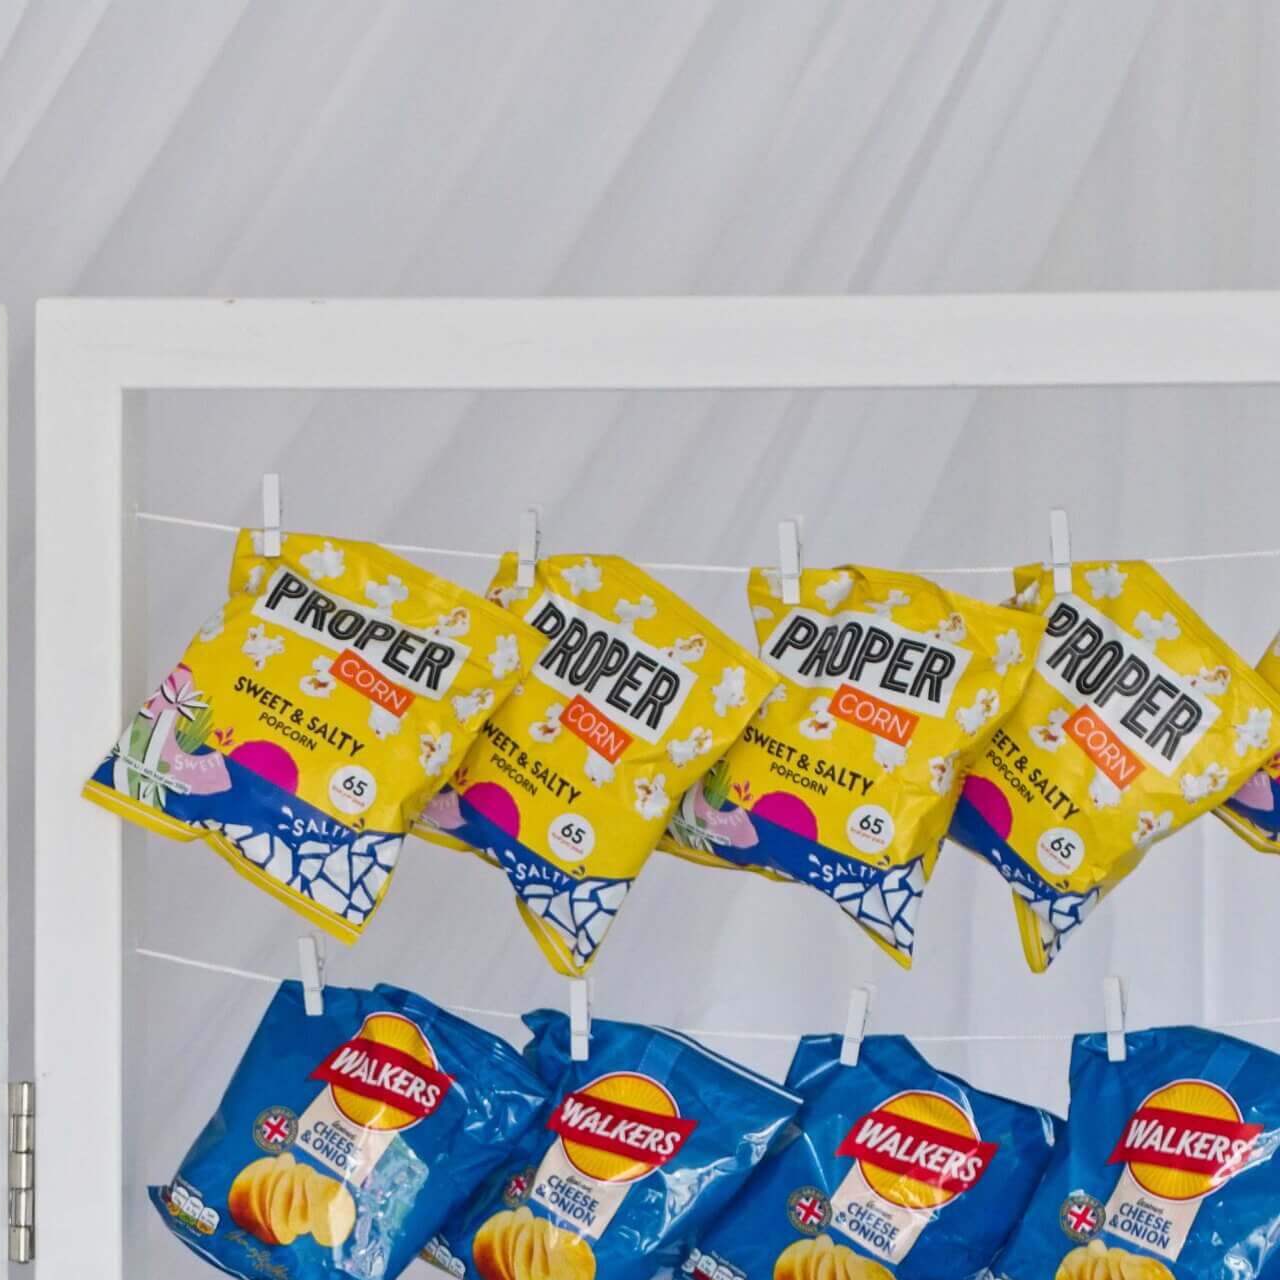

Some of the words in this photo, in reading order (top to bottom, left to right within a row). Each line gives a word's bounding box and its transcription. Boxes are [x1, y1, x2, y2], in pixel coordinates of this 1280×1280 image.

[265, 571, 458, 686] PROPER
[340, 659, 408, 711] CORN
[234, 676, 293, 714] SWEET
[294, 706, 306, 724] &
[307, 716, 365, 757] SALTY
[259, 711, 318, 751] POPCORN
[569, 704, 624, 754] CORN
[838, 694, 910, 739] CORN
[480, 720, 519, 758] WEET
[518, 751, 529, 768] &
[531, 761, 582, 805] SALTY
[743, 726, 797, 759] SWEET
[798, 754, 810, 770] &
[814, 759, 874, 796] SALTY
[1073, 716, 1136, 781] CORN
[342, 775, 368, 797] 65
[490, 754, 538, 796] POPCORN
[770, 762, 828, 796] POPCORN
[985, 750, 1035, 803] POPCORN
[992, 728, 1020, 758] EET
[1014, 754, 1029, 772] &
[1028, 763, 1081, 821] SALTY
[561, 824, 586, 844] 65
[859, 814, 884, 835] 65
[1050, 837, 1076, 859] 65
[329, 1047, 440, 1109] WALKERS
[313, 1120, 360, 1158] CHEES
[560, 1098, 681, 1155] WALKERS
[1124, 1119, 1249, 1164] WALKERS
[300, 1130, 312, 1144] &
[312, 1137, 355, 1172] ONIO
[855, 1118, 983, 1182] WALKERS
[535, 1184, 546, 1198] &
[548, 1190, 597, 1227] ONION
[547, 1174, 599, 1214] CHEESE
[835, 1211, 847, 1225] &
[848, 1218, 896, 1256] ONION
[847, 1201, 901, 1241] CHEESE
[1108, 1214, 1120, 1227] &
[1120, 1219, 1170, 1250] ONION
[1119, 1204, 1173, 1234] CHEESE
